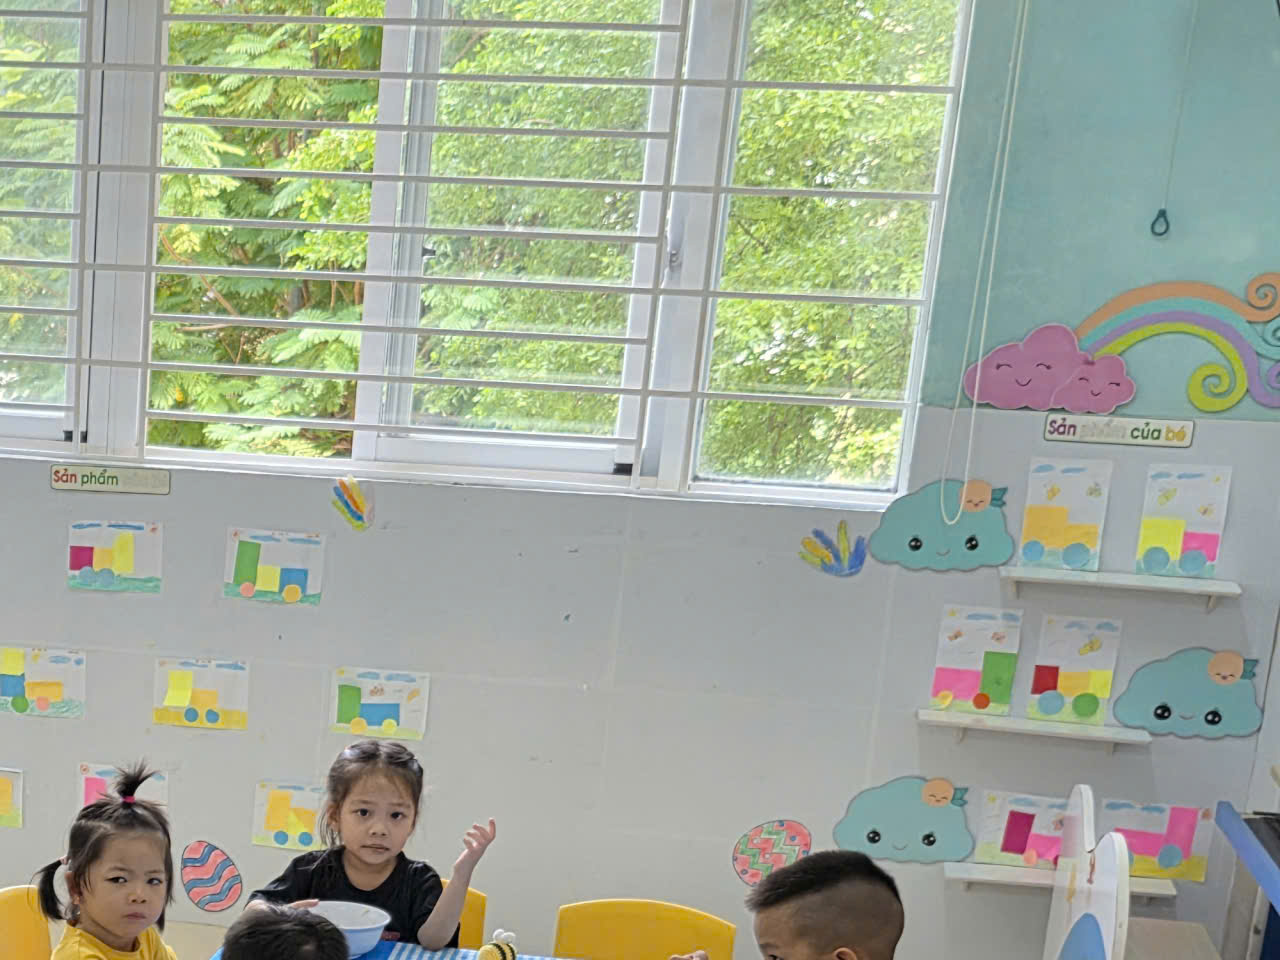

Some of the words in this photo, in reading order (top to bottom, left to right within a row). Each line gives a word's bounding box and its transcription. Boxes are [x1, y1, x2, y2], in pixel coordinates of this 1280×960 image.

[1048, 417, 1077, 436] Sản
[1130, 422, 1162, 441] của
[53, 468, 77, 484] Sản
[80, 469, 119, 487] phẩm
